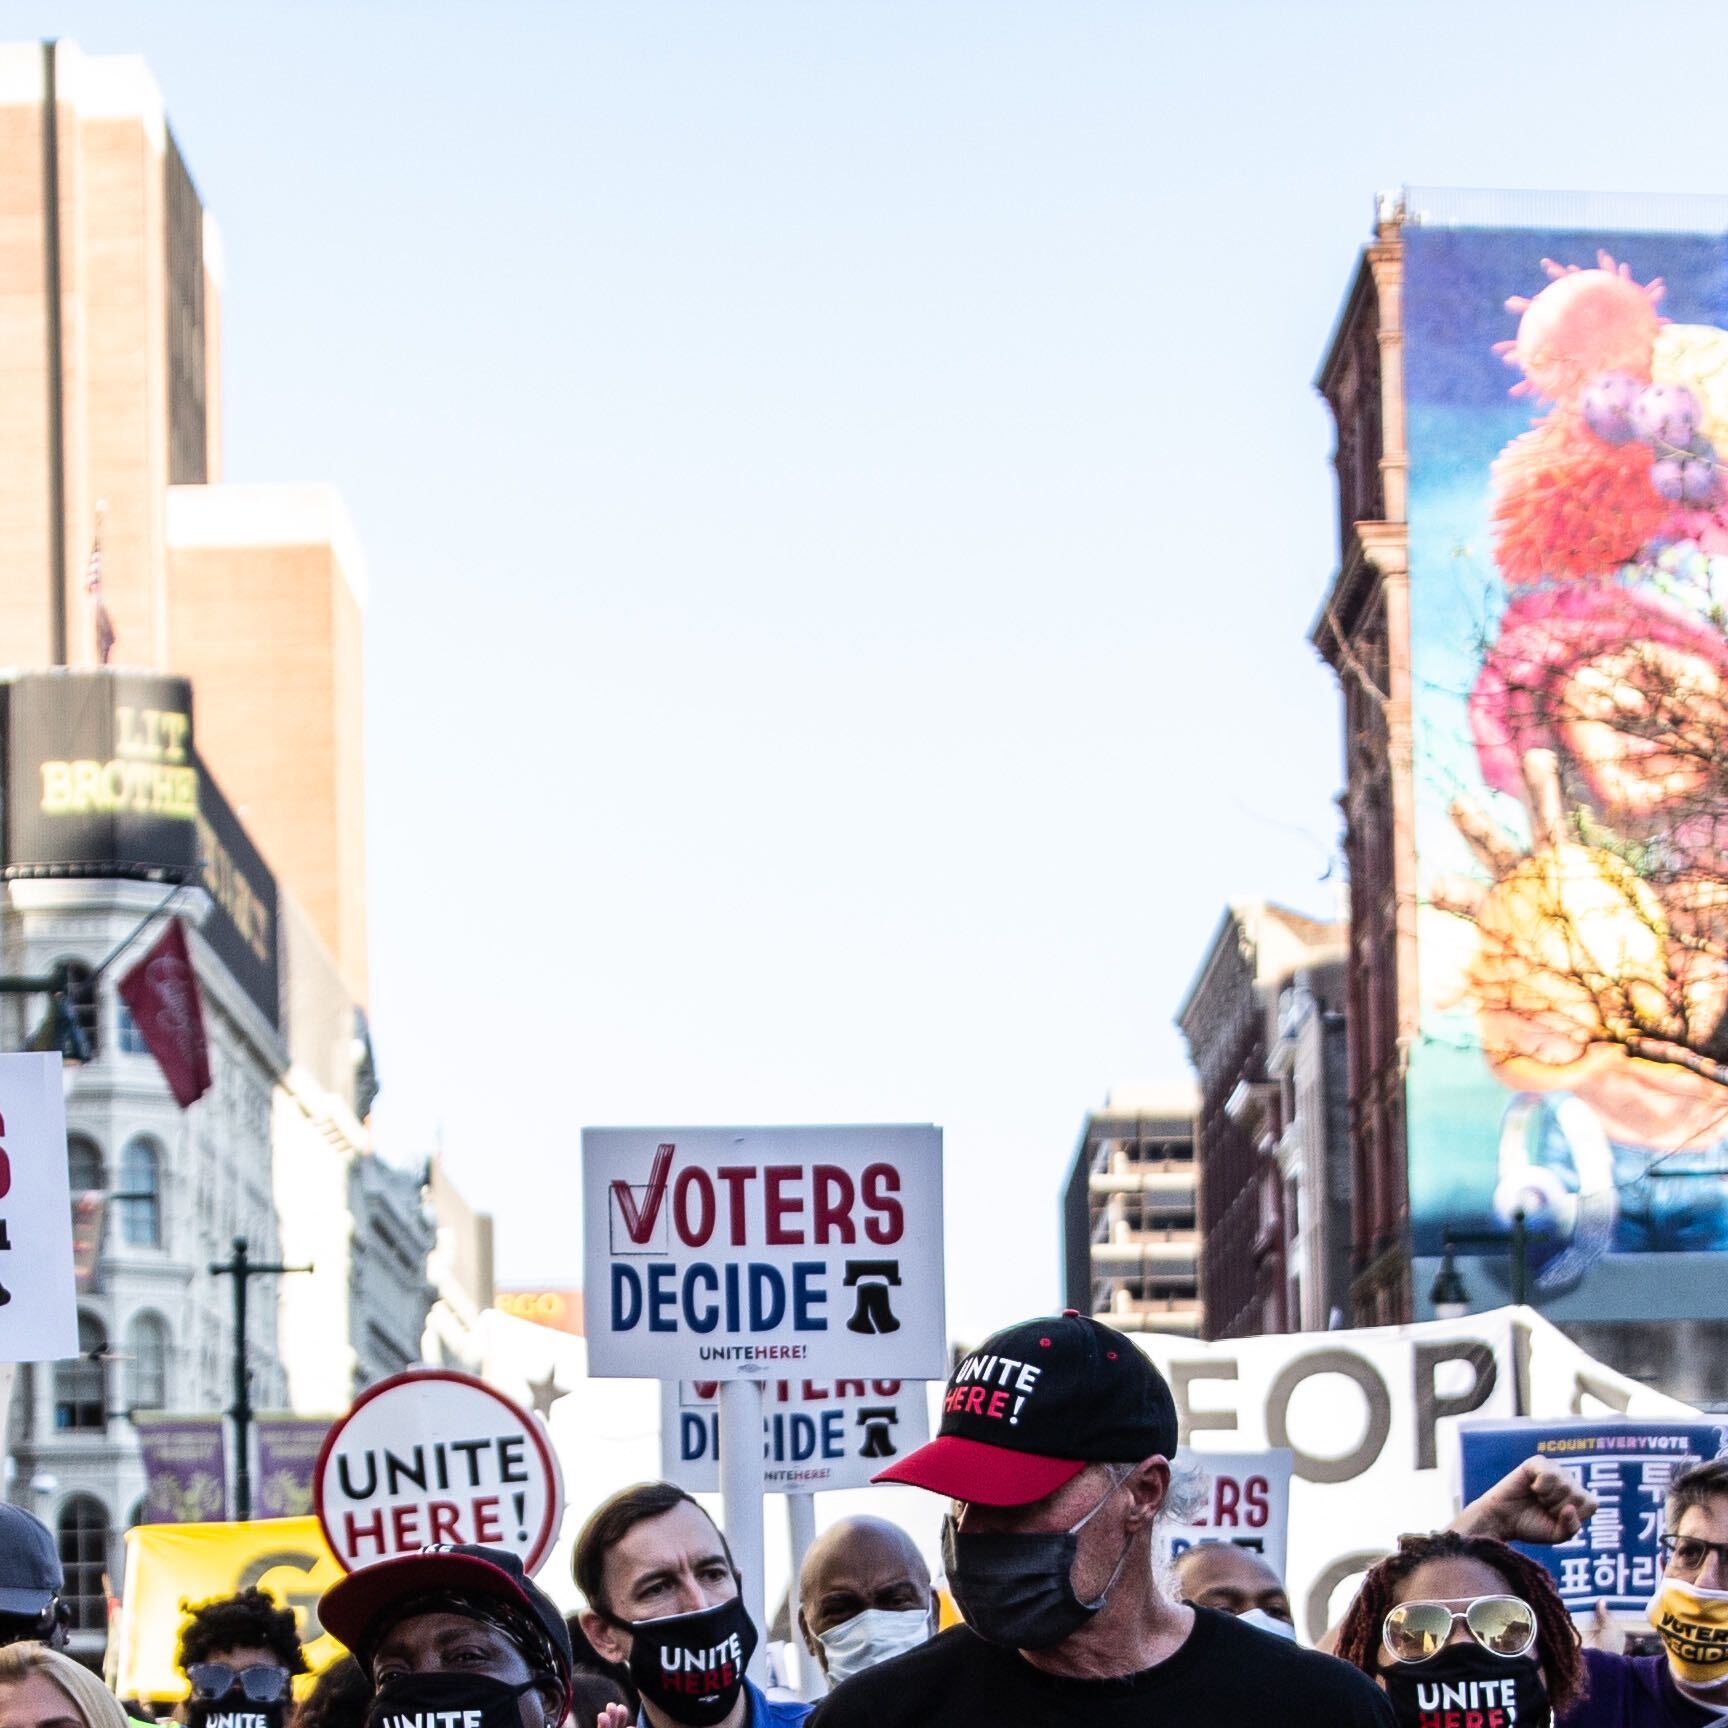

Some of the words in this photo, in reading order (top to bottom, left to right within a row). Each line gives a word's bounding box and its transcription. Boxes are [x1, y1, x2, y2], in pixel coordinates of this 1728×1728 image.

[612, 1144, 905, 1248] VOTERS
[611, 1261, 828, 1332] DECIDE
[699, 1346, 807, 1360] UNITEHERE!
[955, 1355, 1041, 1394] UNITE
[944, 1385, 1025, 1425] HERE!
[681, 1409, 845, 1462] DIDE
[1537, 1436, 1689, 1453] #COUNTEVERYVOTE
[338, 1435, 528, 1500] UNITE
[344, 1490, 529, 1558] HERE!
[660, 1631, 743, 1671] UNITE
[661, 1657, 742, 1696] HERE!
[1416, 1679, 1515, 1710] UNITE
